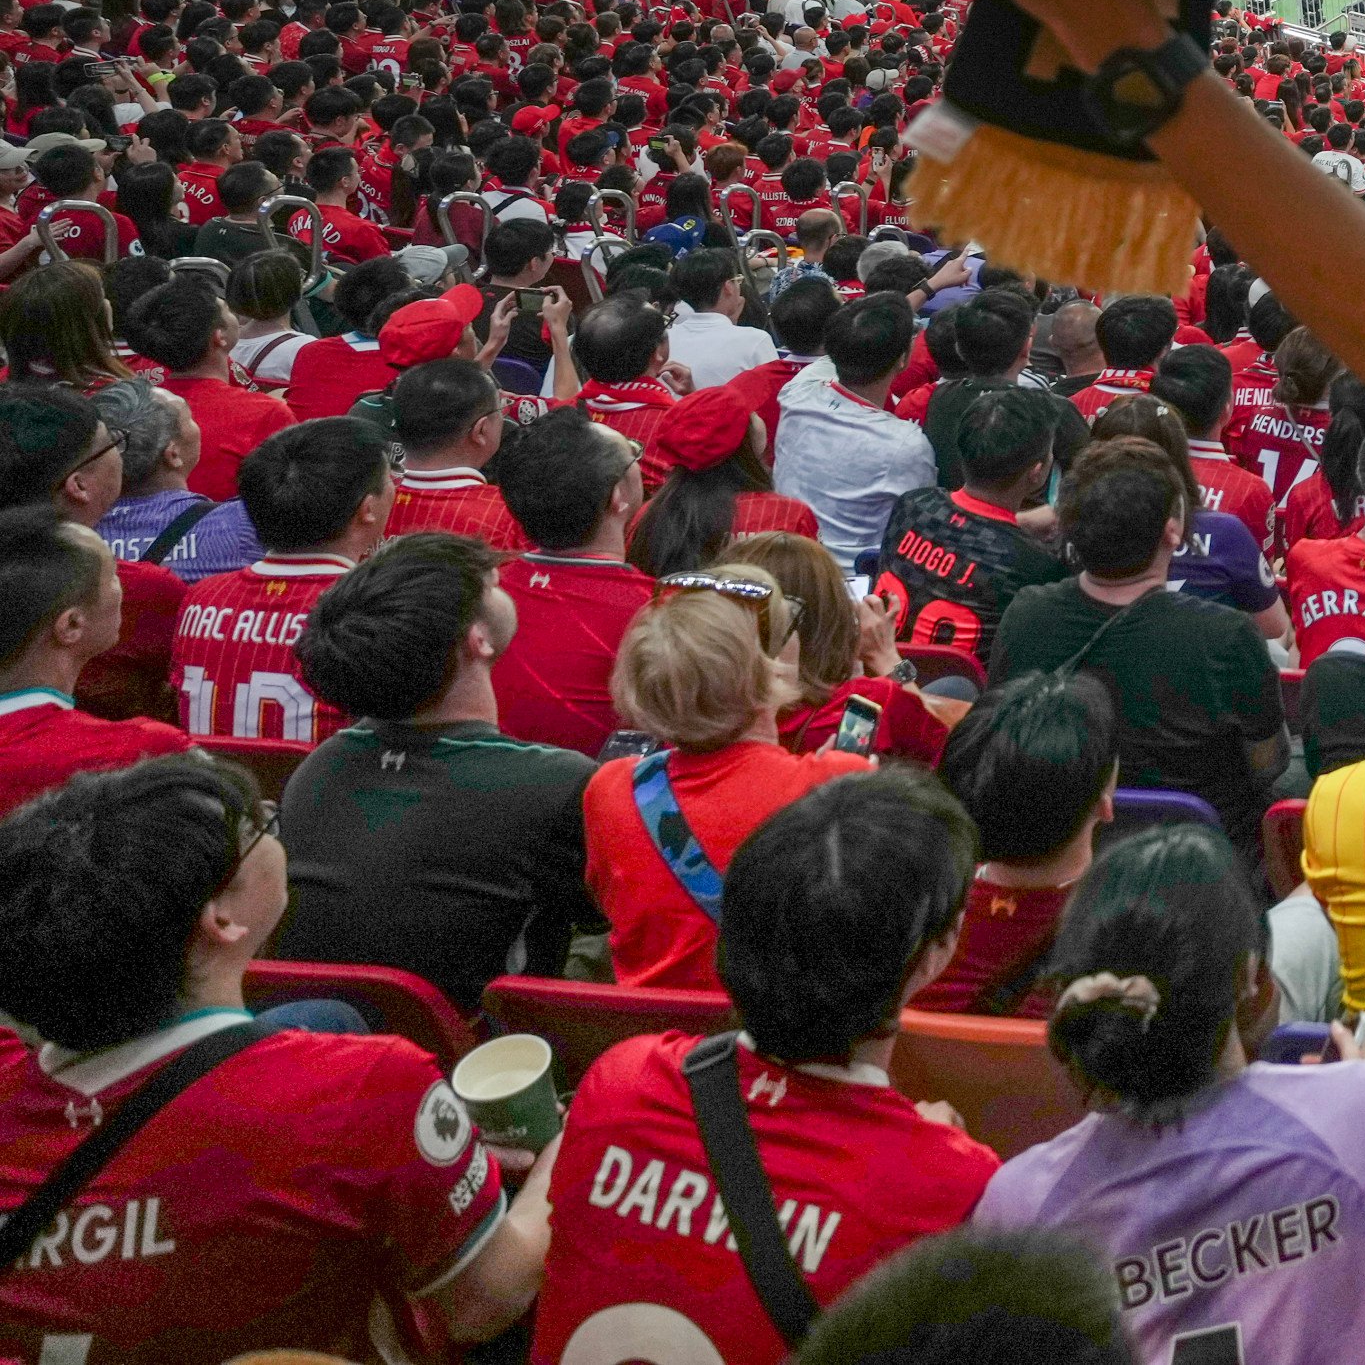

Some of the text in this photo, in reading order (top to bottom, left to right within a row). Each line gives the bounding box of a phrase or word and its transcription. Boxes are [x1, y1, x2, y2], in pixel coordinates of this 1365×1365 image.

[1250, 413, 1325, 446] HENDERS
[898, 530, 974, 589] DIOGO J.
[180, 605, 307, 646] MAC ALLIS
[15, 1197, 176, 1270] RGIL
[1112, 1194, 1341, 1312] BECKER
